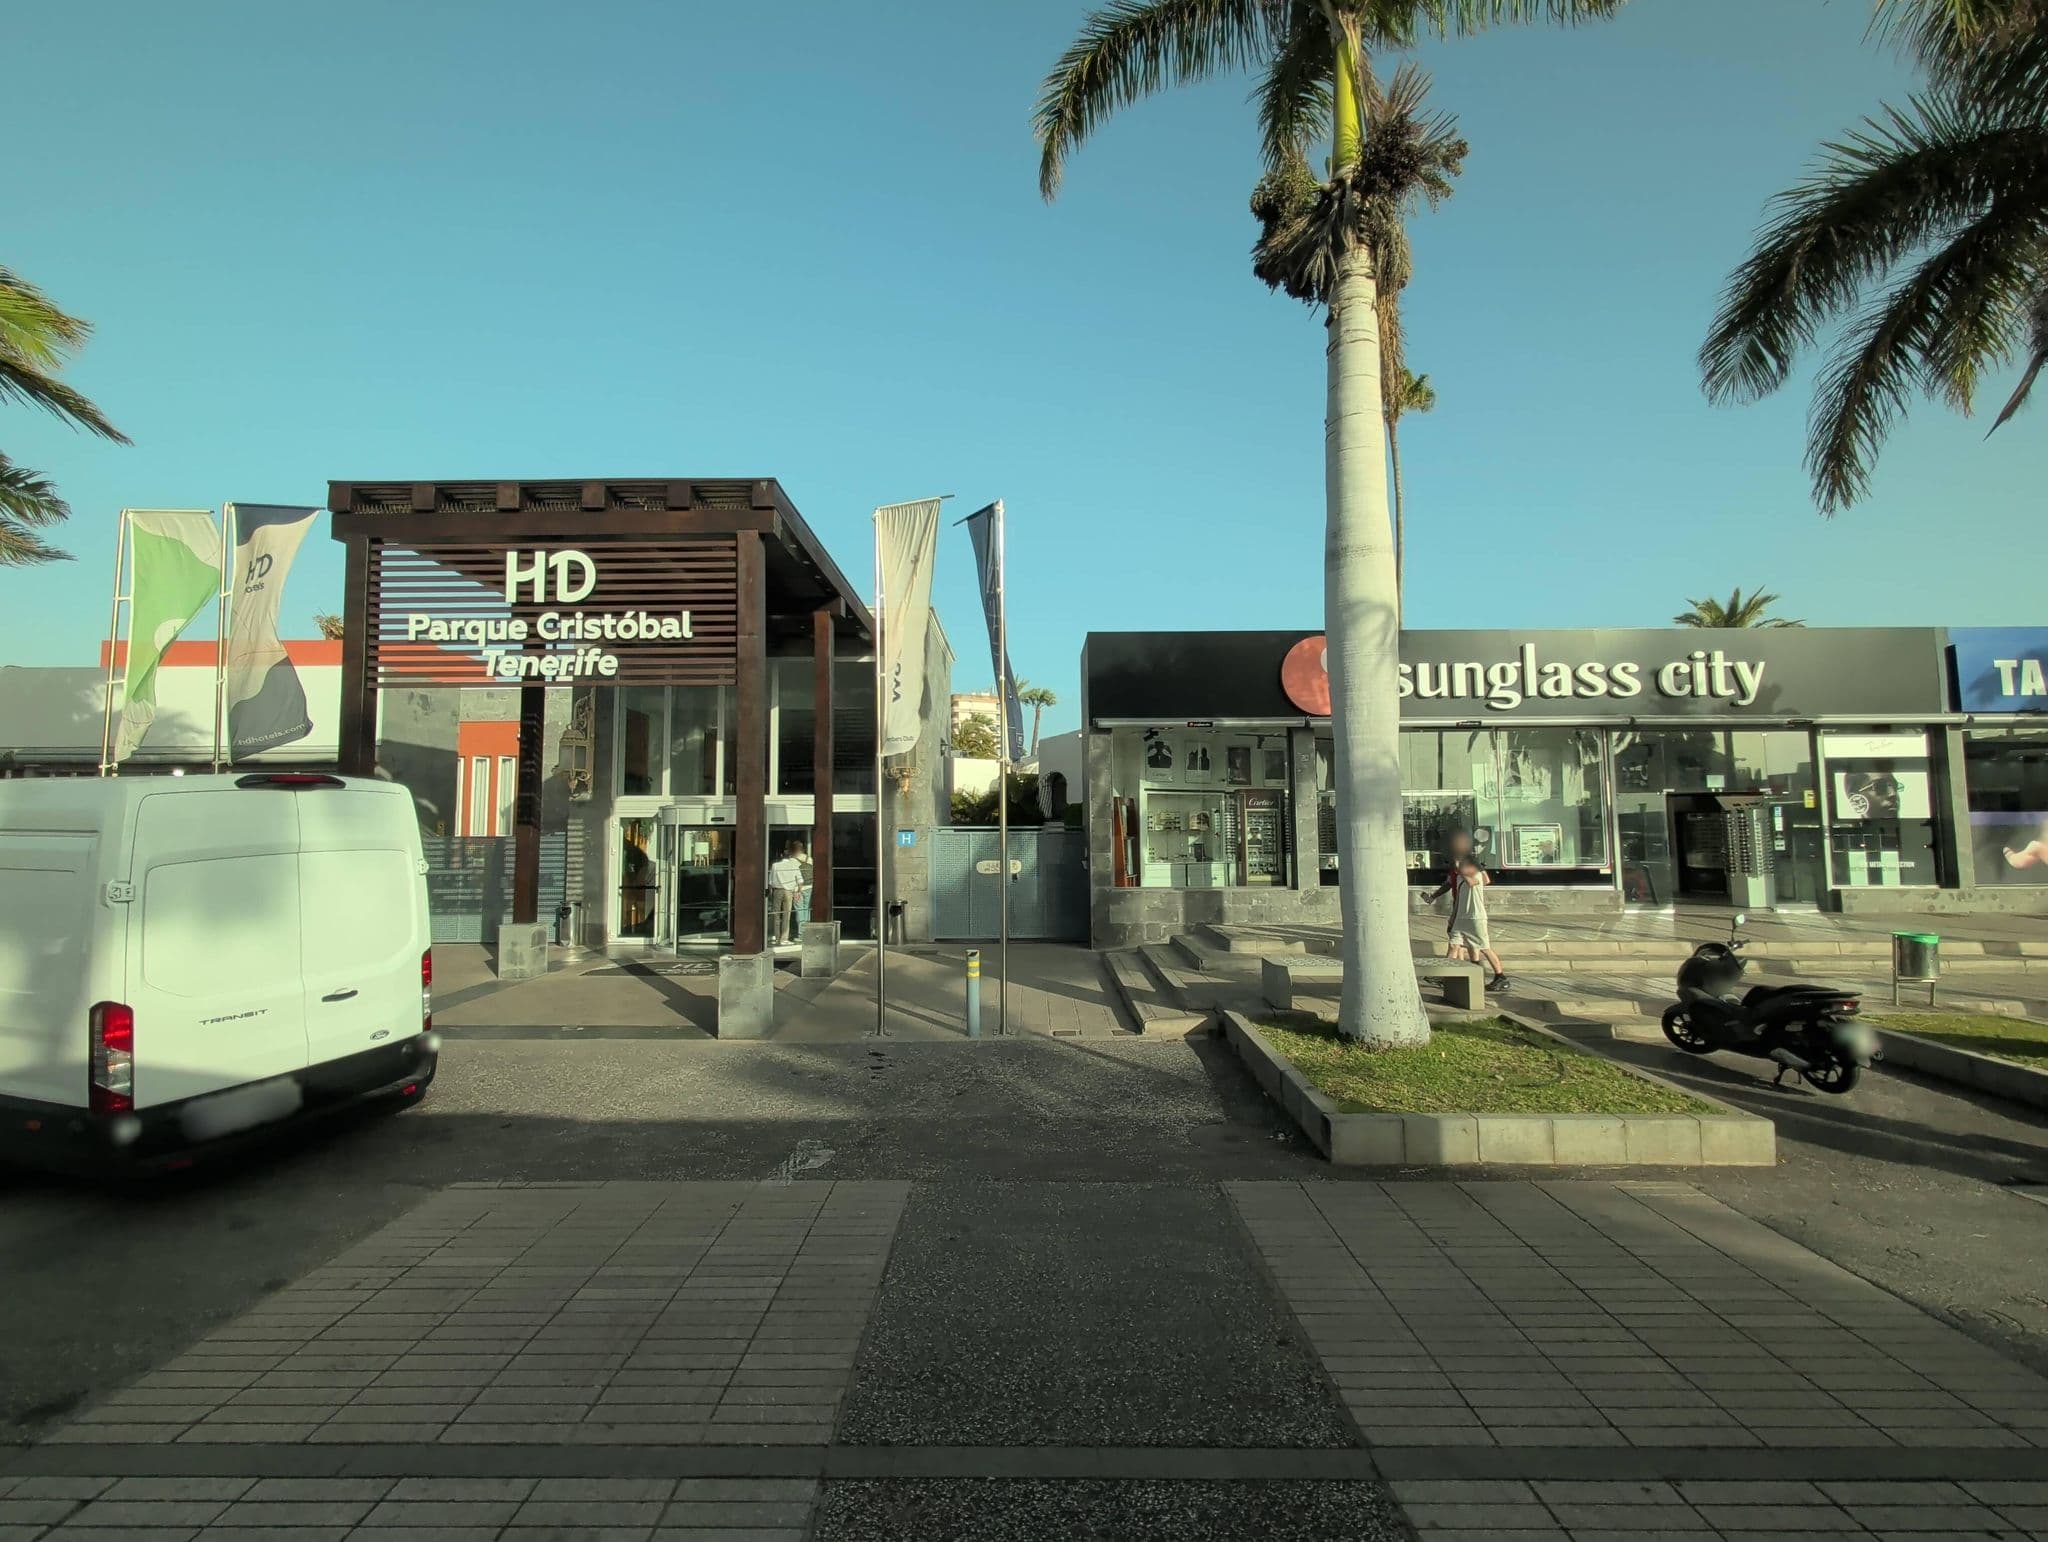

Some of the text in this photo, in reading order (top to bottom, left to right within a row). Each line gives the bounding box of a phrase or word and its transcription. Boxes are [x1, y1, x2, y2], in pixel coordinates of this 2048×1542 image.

[245, 553, 273, 584] HD
[505, 550, 596, 603] HD
[408, 611, 693, 648] Parque Cristóbal
[483, 648, 619, 677] Tenerife
[1659, 651, 1765, 706] city
[902, 833, 911, 844] H
[199, 1009, 268, 1026] TRANSIT
